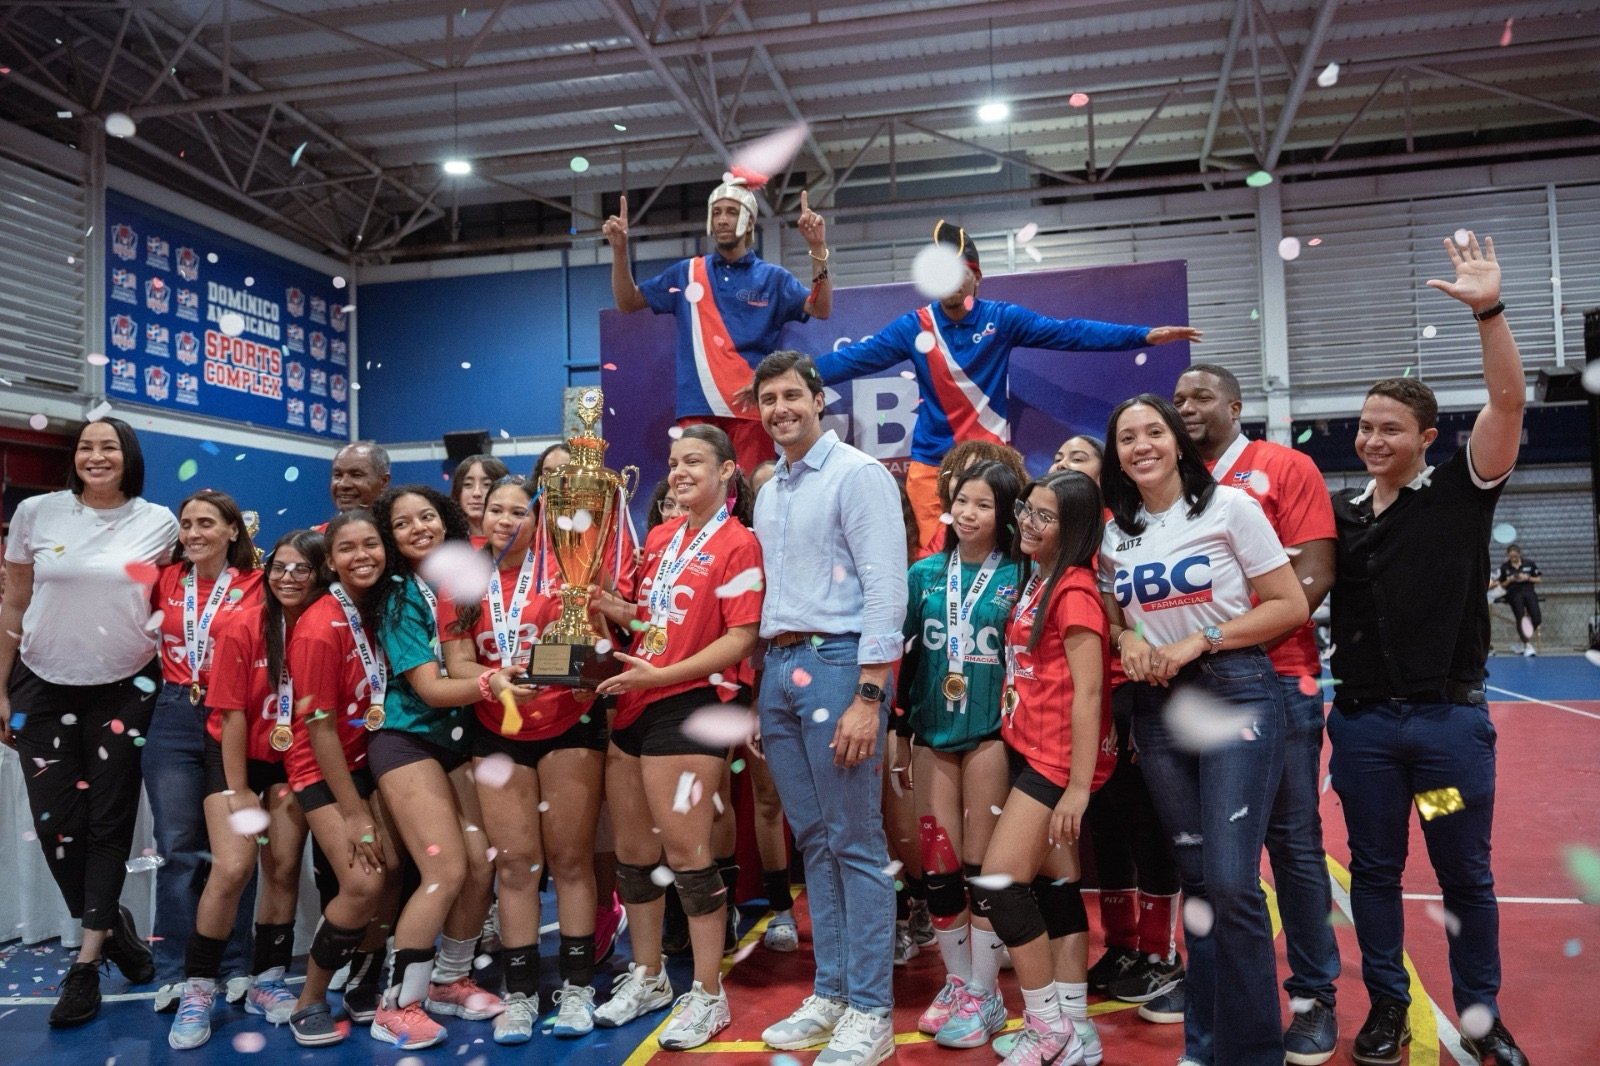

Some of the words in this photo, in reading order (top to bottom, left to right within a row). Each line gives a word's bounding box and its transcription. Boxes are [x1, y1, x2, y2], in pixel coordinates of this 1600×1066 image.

[208, 281, 280, 322] DOMÍNICO
[206, 303, 280, 341] AMICANO
[204, 329, 283, 376] SPORTS
[204, 360, 283, 401] COMPLEX
[689, 531, 708, 551] BLITZ
[518, 575, 530, 594] BLITZ
[972, 572, 988, 595] BLITZ
[1114, 554, 1213, 609] GBC
[950, 602, 958, 626] BLITZ
[498, 633, 508, 653] GBC
[950, 636, 959, 657] GBC
[359, 643, 372, 667] BLITZ
[964, 655, 998, 664] RMACIAS
[370, 674, 381, 692] GBC
[281, 695, 289, 717] GBC
